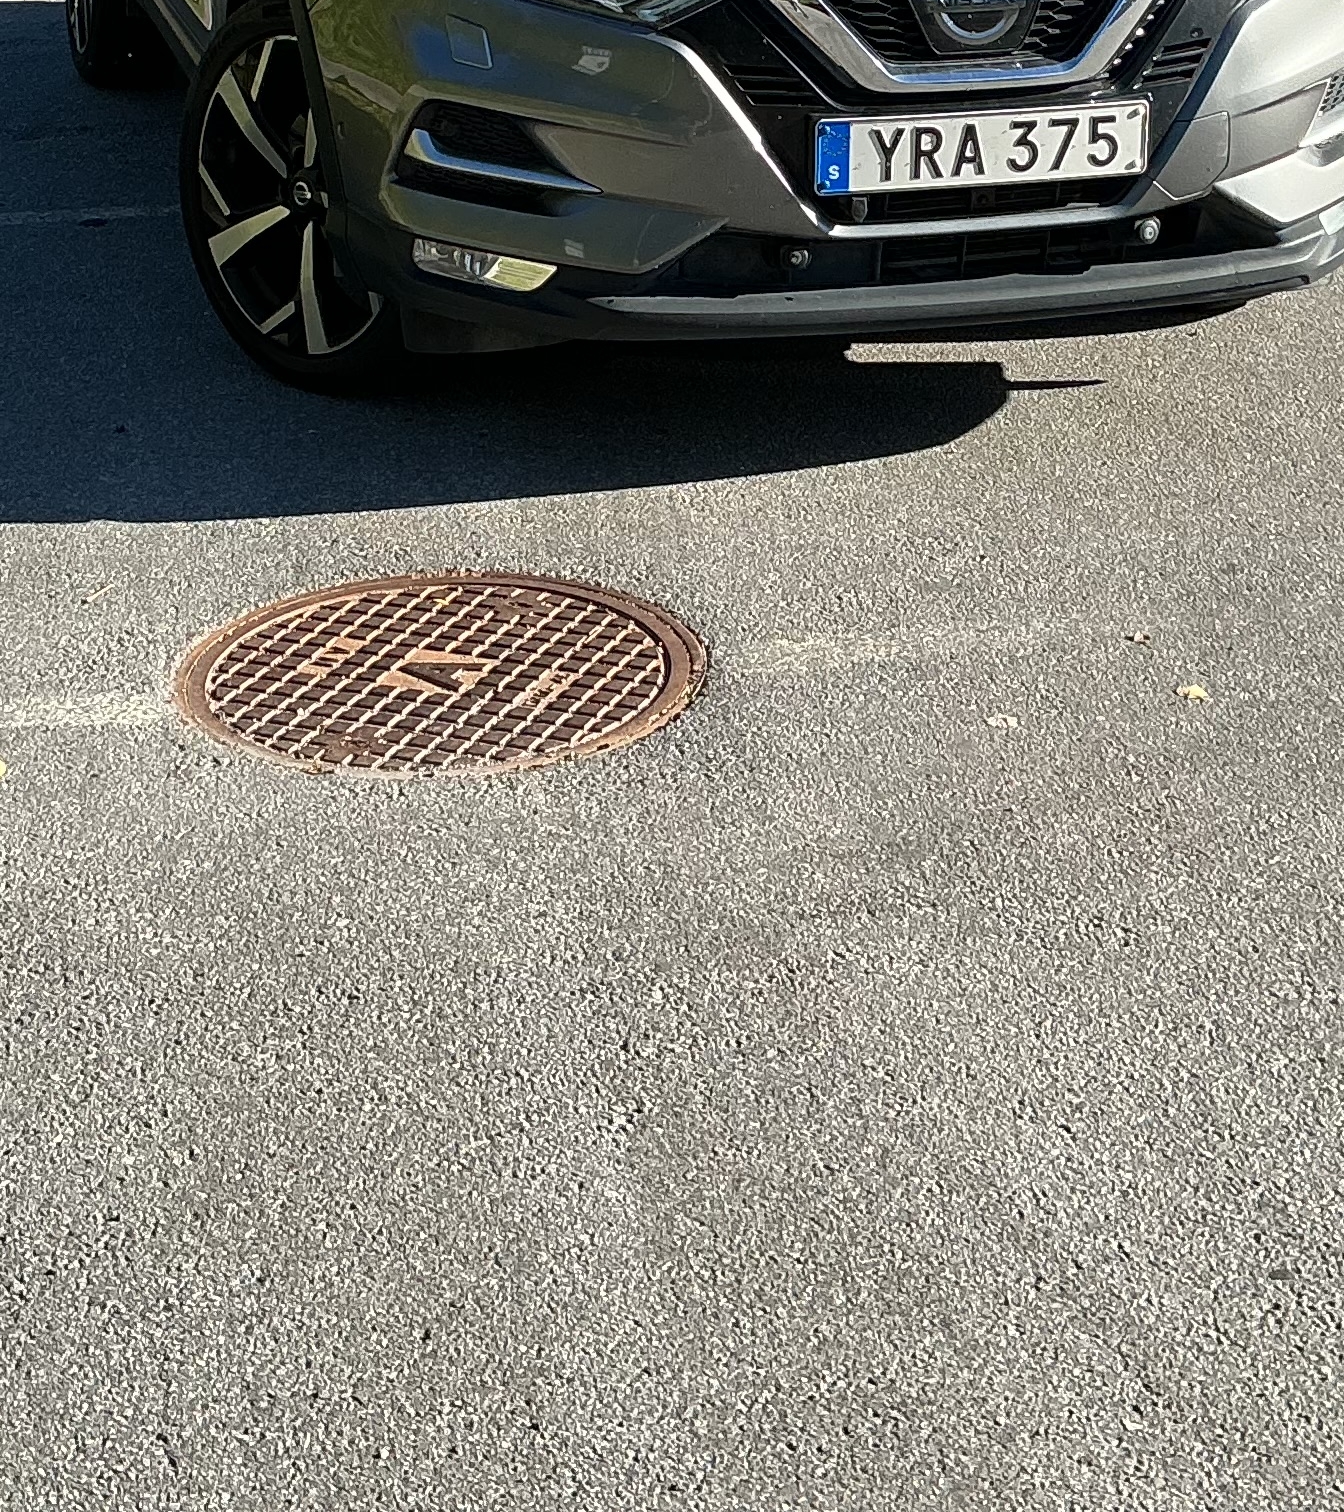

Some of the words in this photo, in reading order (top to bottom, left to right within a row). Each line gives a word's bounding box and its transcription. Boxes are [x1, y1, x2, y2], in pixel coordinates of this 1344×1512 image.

[868, 122, 987, 183] YRA
[1006, 115, 1119, 174] 375
[828, 165, 840, 180] S
